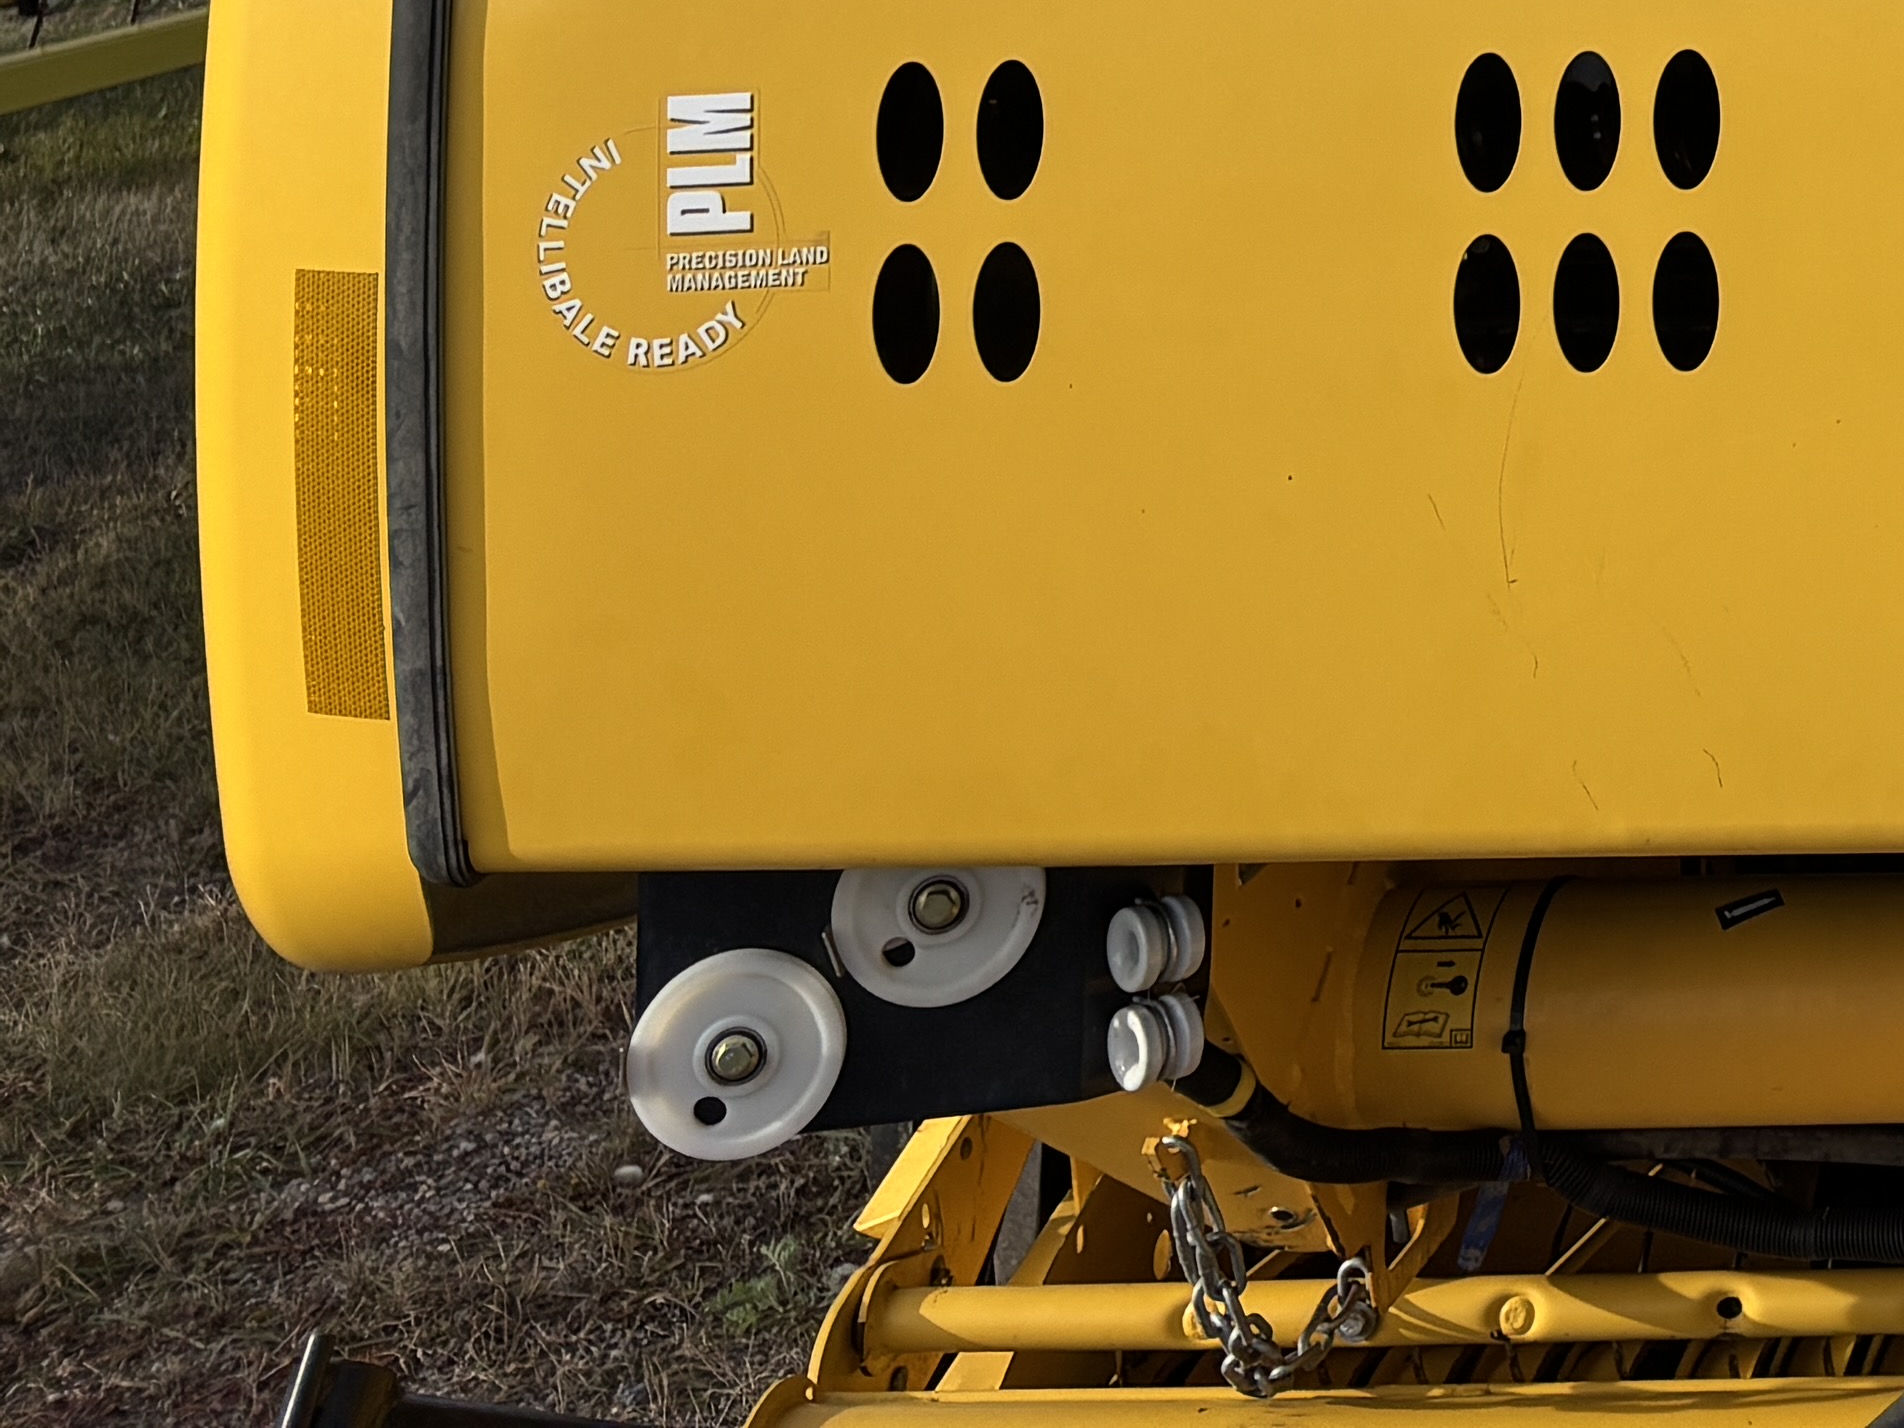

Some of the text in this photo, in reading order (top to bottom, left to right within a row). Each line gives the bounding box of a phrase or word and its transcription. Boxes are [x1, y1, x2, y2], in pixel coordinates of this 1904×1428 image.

[667, 92, 754, 236] PLM
[538, 138, 623, 359] INTELLIBALE
[666, 246, 829, 271] PRECISION LAND
[666, 269, 807, 293] MANAGEMENT
[627, 300, 745, 368] READY
